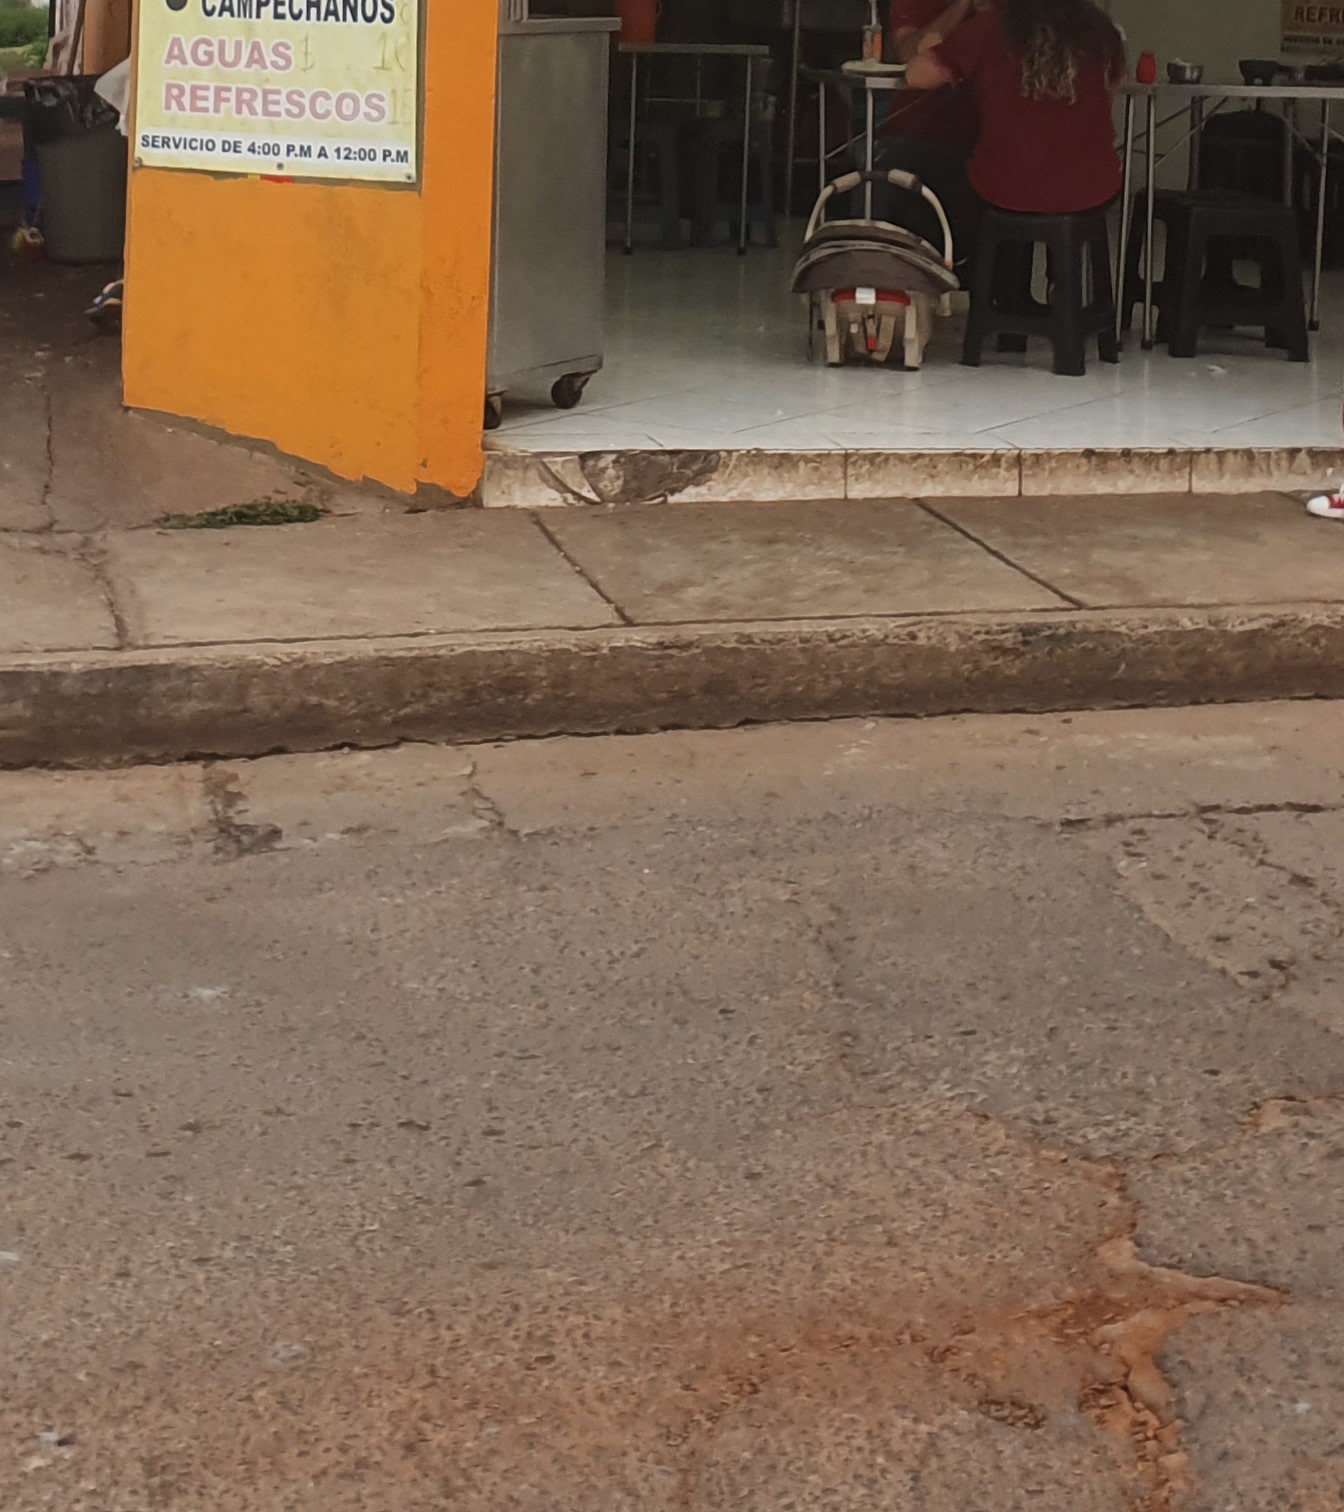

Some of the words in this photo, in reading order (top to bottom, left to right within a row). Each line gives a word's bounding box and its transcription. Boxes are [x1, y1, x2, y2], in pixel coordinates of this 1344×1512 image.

[164, 36, 293, 71] AGUAS
[163, 83, 387, 123] REFRESCOS
[141, 135, 216, 152] SERVICIO
[221, 139, 242, 154] DE
[247, 141, 281, 157] 4:00
[286, 144, 312, 159] P.M
[317, 145, 329, 160] A
[334, 146, 377, 162] 12:00
[382, 149, 409, 164] P.M
